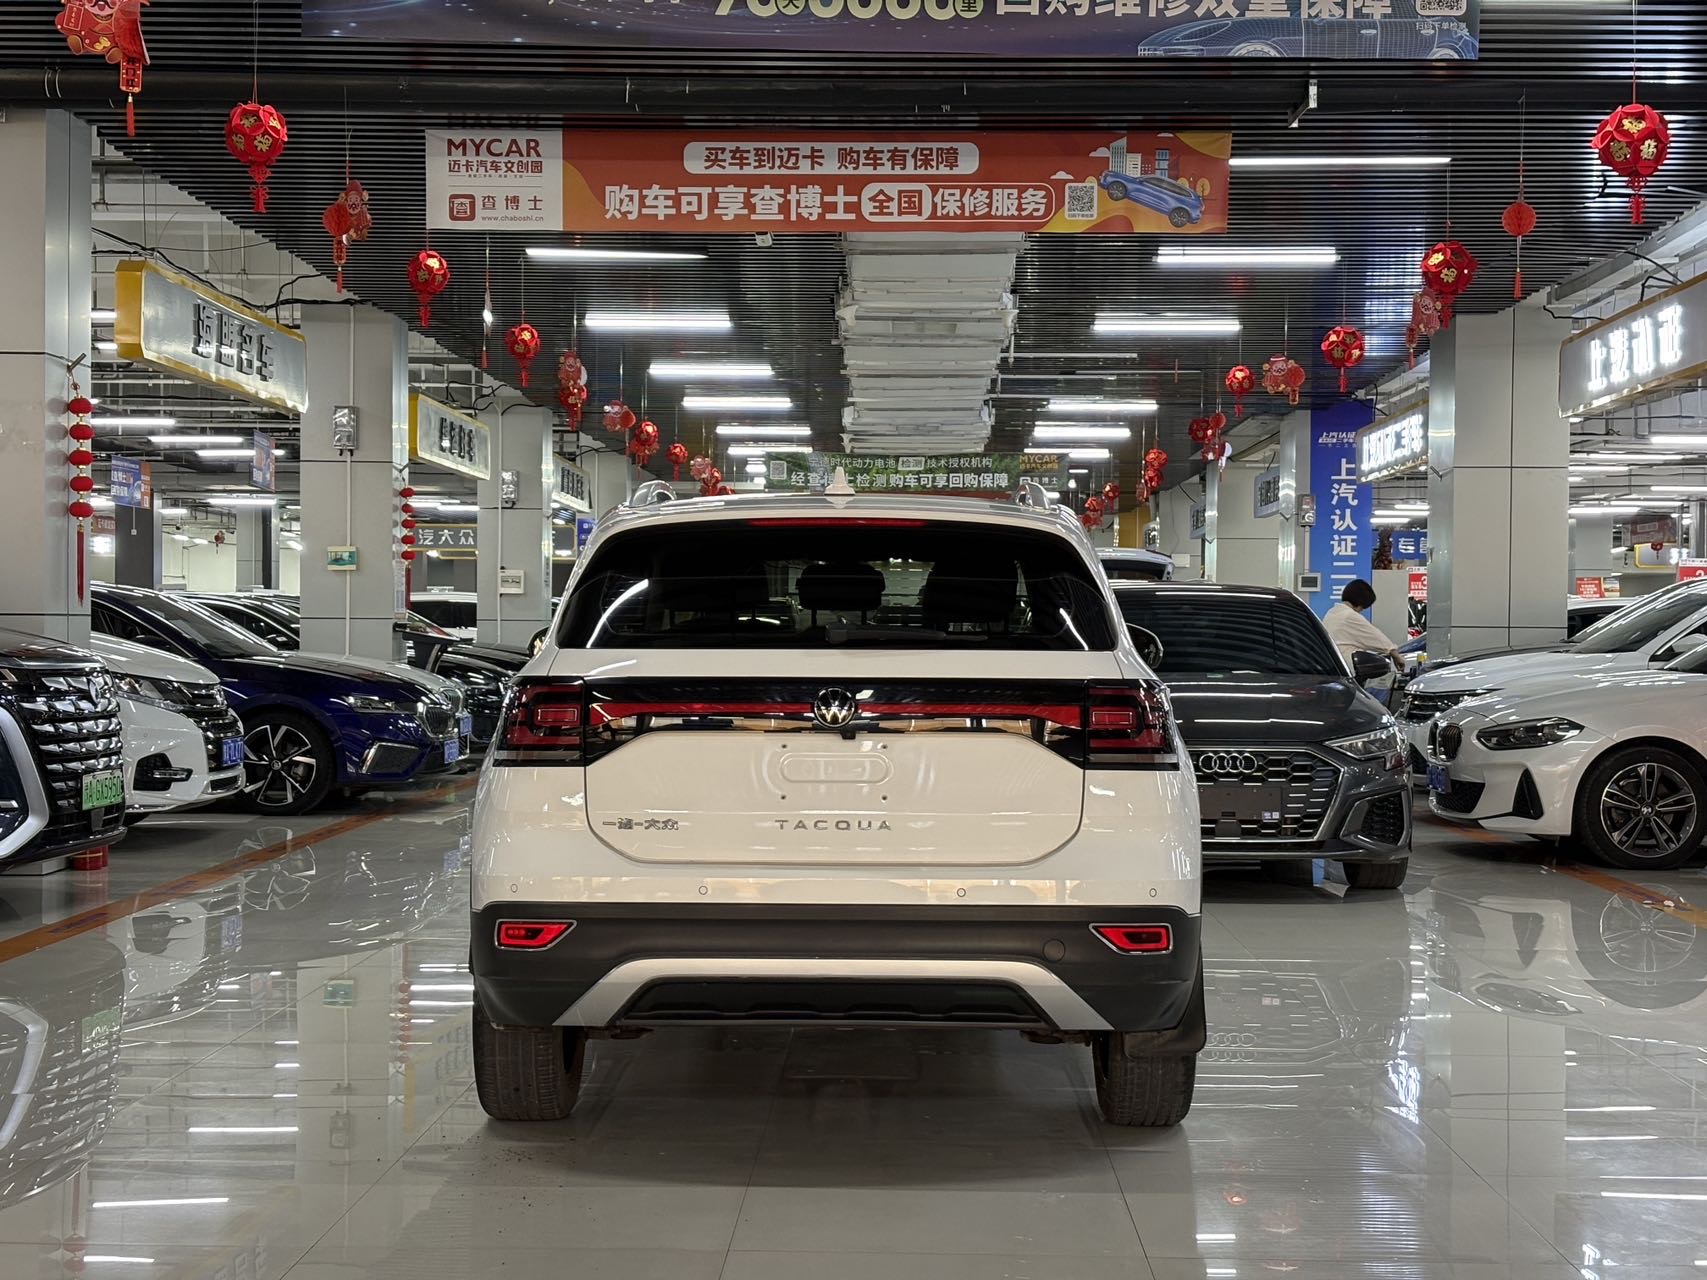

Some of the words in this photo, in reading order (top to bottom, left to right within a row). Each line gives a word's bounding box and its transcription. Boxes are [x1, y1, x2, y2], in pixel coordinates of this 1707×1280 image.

[447, 138, 542, 158] MYCAR
[703, 146, 825, 171] 买车到迈卡
[837, 146, 960, 171] 购车有保障
[448, 159, 543, 174] 迈卡汽车文创园
[481, 195, 543, 211] 查博士
[481, 214, 544, 222] www.chaboshi.cn
[926, 457, 993, 469] 技术授权机构
[1020, 455, 1058, 463] MYCAR
[790, 471, 1009, 488] 经查检测购车可享回购保障
[418, 529, 475, 546] 汽大众
[775, 819, 892, 831] TACQUA
